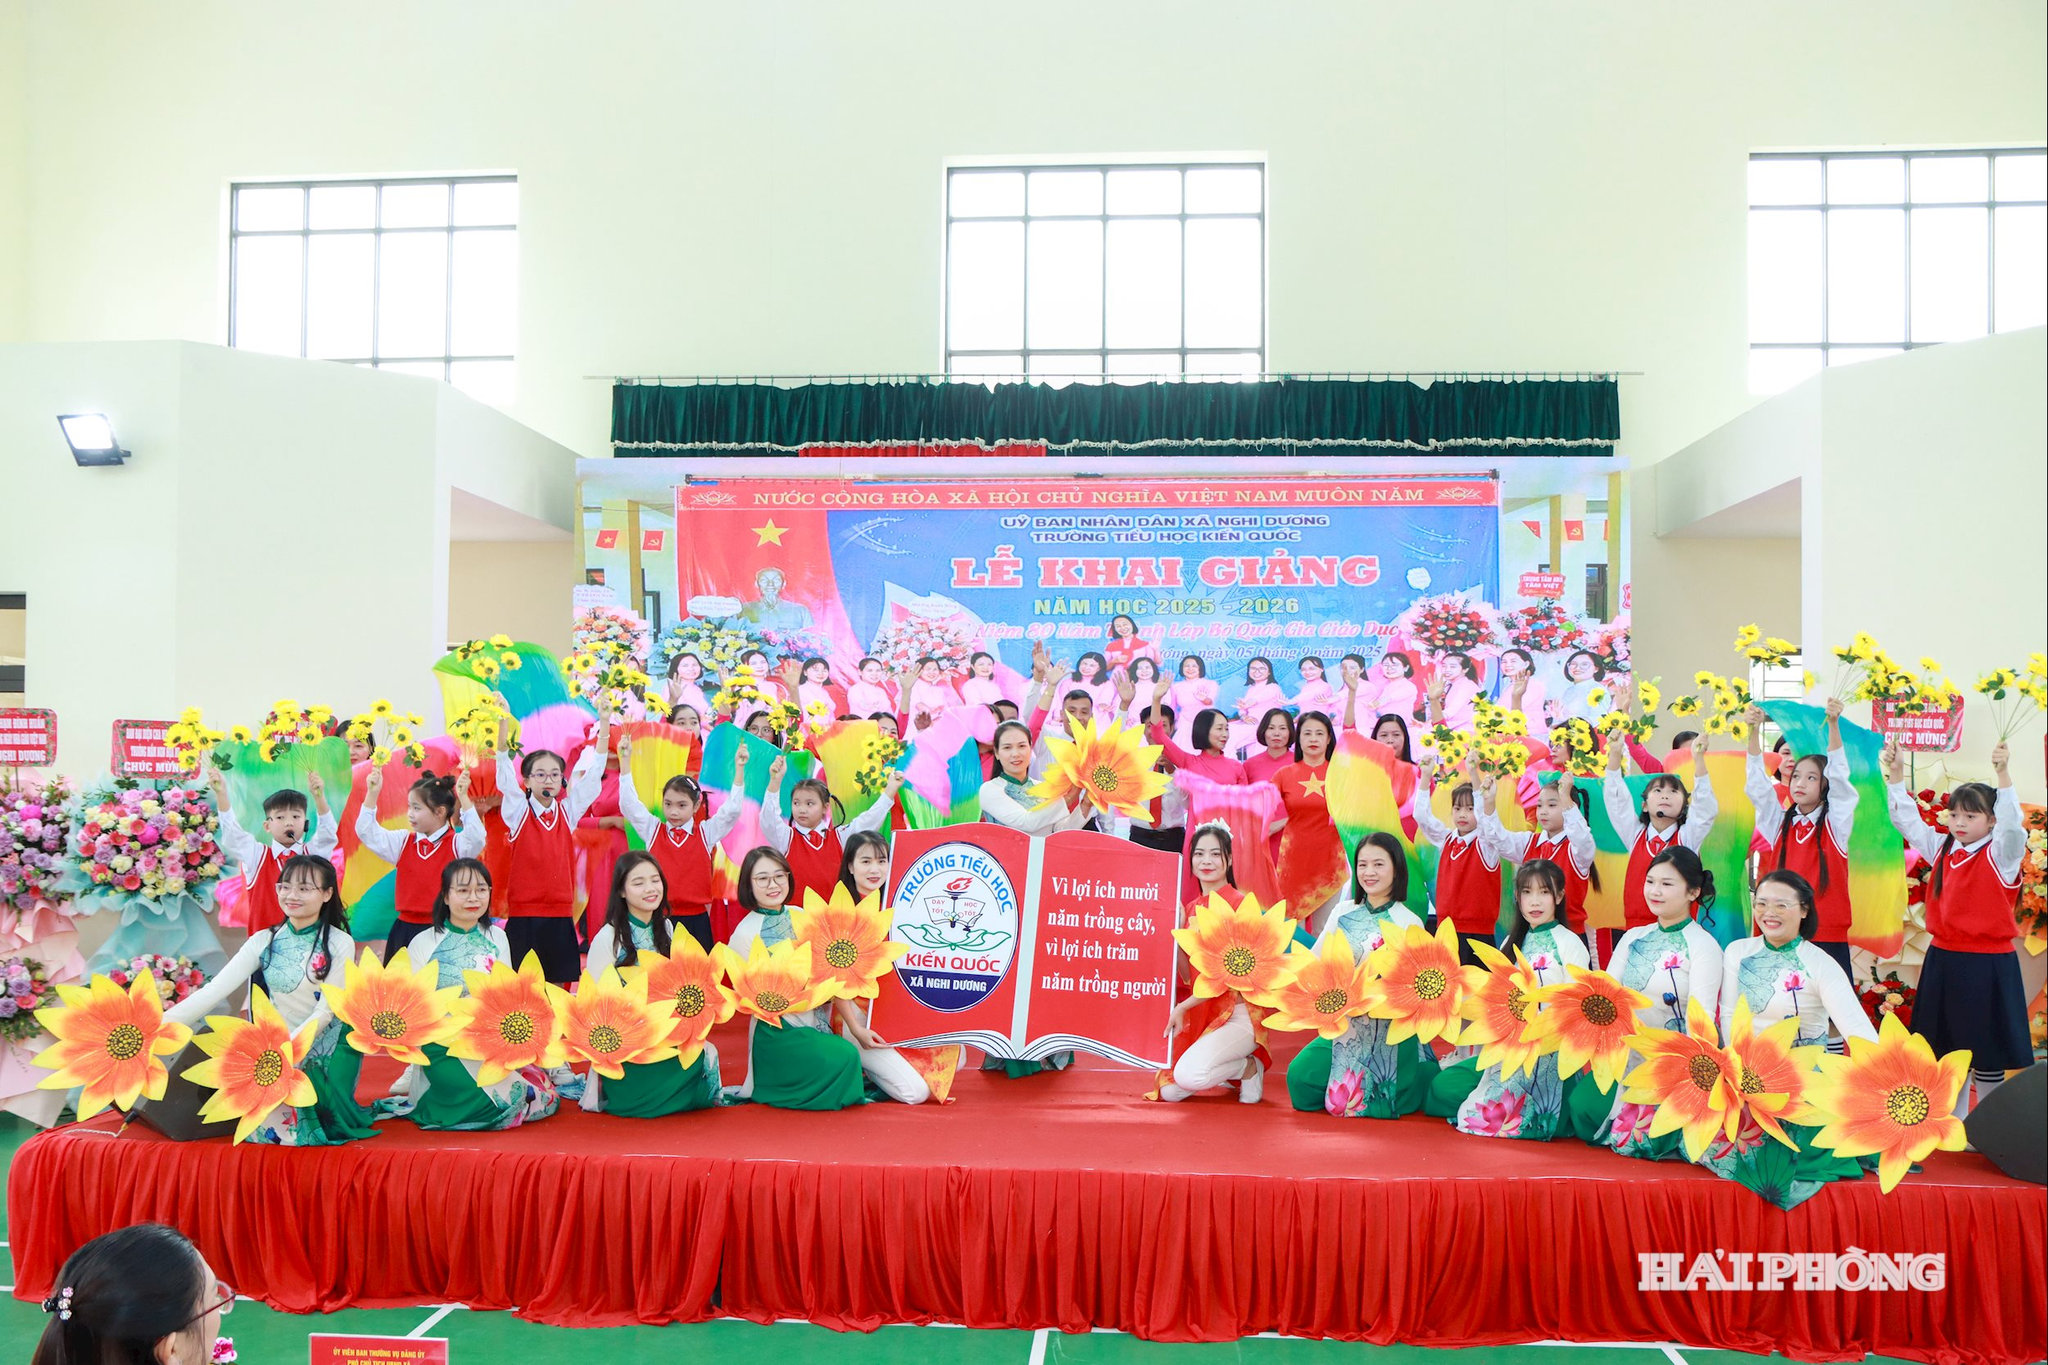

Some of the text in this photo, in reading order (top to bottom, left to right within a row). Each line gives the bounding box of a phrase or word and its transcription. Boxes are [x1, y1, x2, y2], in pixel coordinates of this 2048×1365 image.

[753, 486, 1424, 507] NƯỚC CỘNG HÒA XÃ HỘI CHỦ NGHĨA VIỆT NAM MUÔN NĂM
[1036, 517, 1073, 528] BAN
[1080, 515, 1130, 527] NHÂN
[1137, 514, 1177, 527] DÂN
[1180, 515, 1211, 527] XÃ
[1217, 516, 1258, 527] NGHI
[1265, 515, 1327, 527] DƯƠNG
[1033, 527, 1300, 545] TRƯỜNG TIỂU HỌC KIẾN QUỐC
[952, 546, 1380, 587] LỄ KHAI GIẢNG
[1034, 596, 1091, 616] NĂM
[1154, 598, 1215, 616] 2025
[1239, 597, 1300, 614] 2026
[975, 621, 1024, 640] Niệm
[1025, 621, 1055, 639] 80
[1058, 620, 1100, 639] Năm
[1168, 621, 1205, 641] Lập
[1208, 621, 1235, 641] Bộ
[1236, 619, 1278, 640] Quốc
[1284, 621, 1315, 638] Gia
[1319, 621, 1361, 638] Giáo
[1363, 620, 1398, 640] Dục
[1198, 646, 1230, 661] ngày
[1236, 646, 1254, 659] 05
[1254, 645, 1297, 661] tháng
[1301, 646, 1310, 658] 9
[1312, 645, 1344, 658] năm
[1915, 729, 1947, 746] MỪNG
[124, 759, 153, 773] CHÚC
[899, 854, 1013, 913] TRƯỜNG TIỂU HỌC
[1051, 876, 1160, 902] Vì lợi ích mười
[1047, 905, 1156, 936] năm trồng cây,
[1045, 937, 1139, 962] vì lợi ích trăm
[905, 950, 1001, 973] KIẾN QUỐC
[910, 975, 988, 992] XÃ NGHI DƯƠNG
[1041, 968, 1167, 1000] năm trồng người
[341, 1347, 355, 1357] VIÊN
[356, 1349, 368, 1357] BAN
[369, 1348, 392, 1358] THƯỜNG
[392, 1349, 400, 1359] VỤ
[400, 1348, 417, 1359] ĐẢNG
